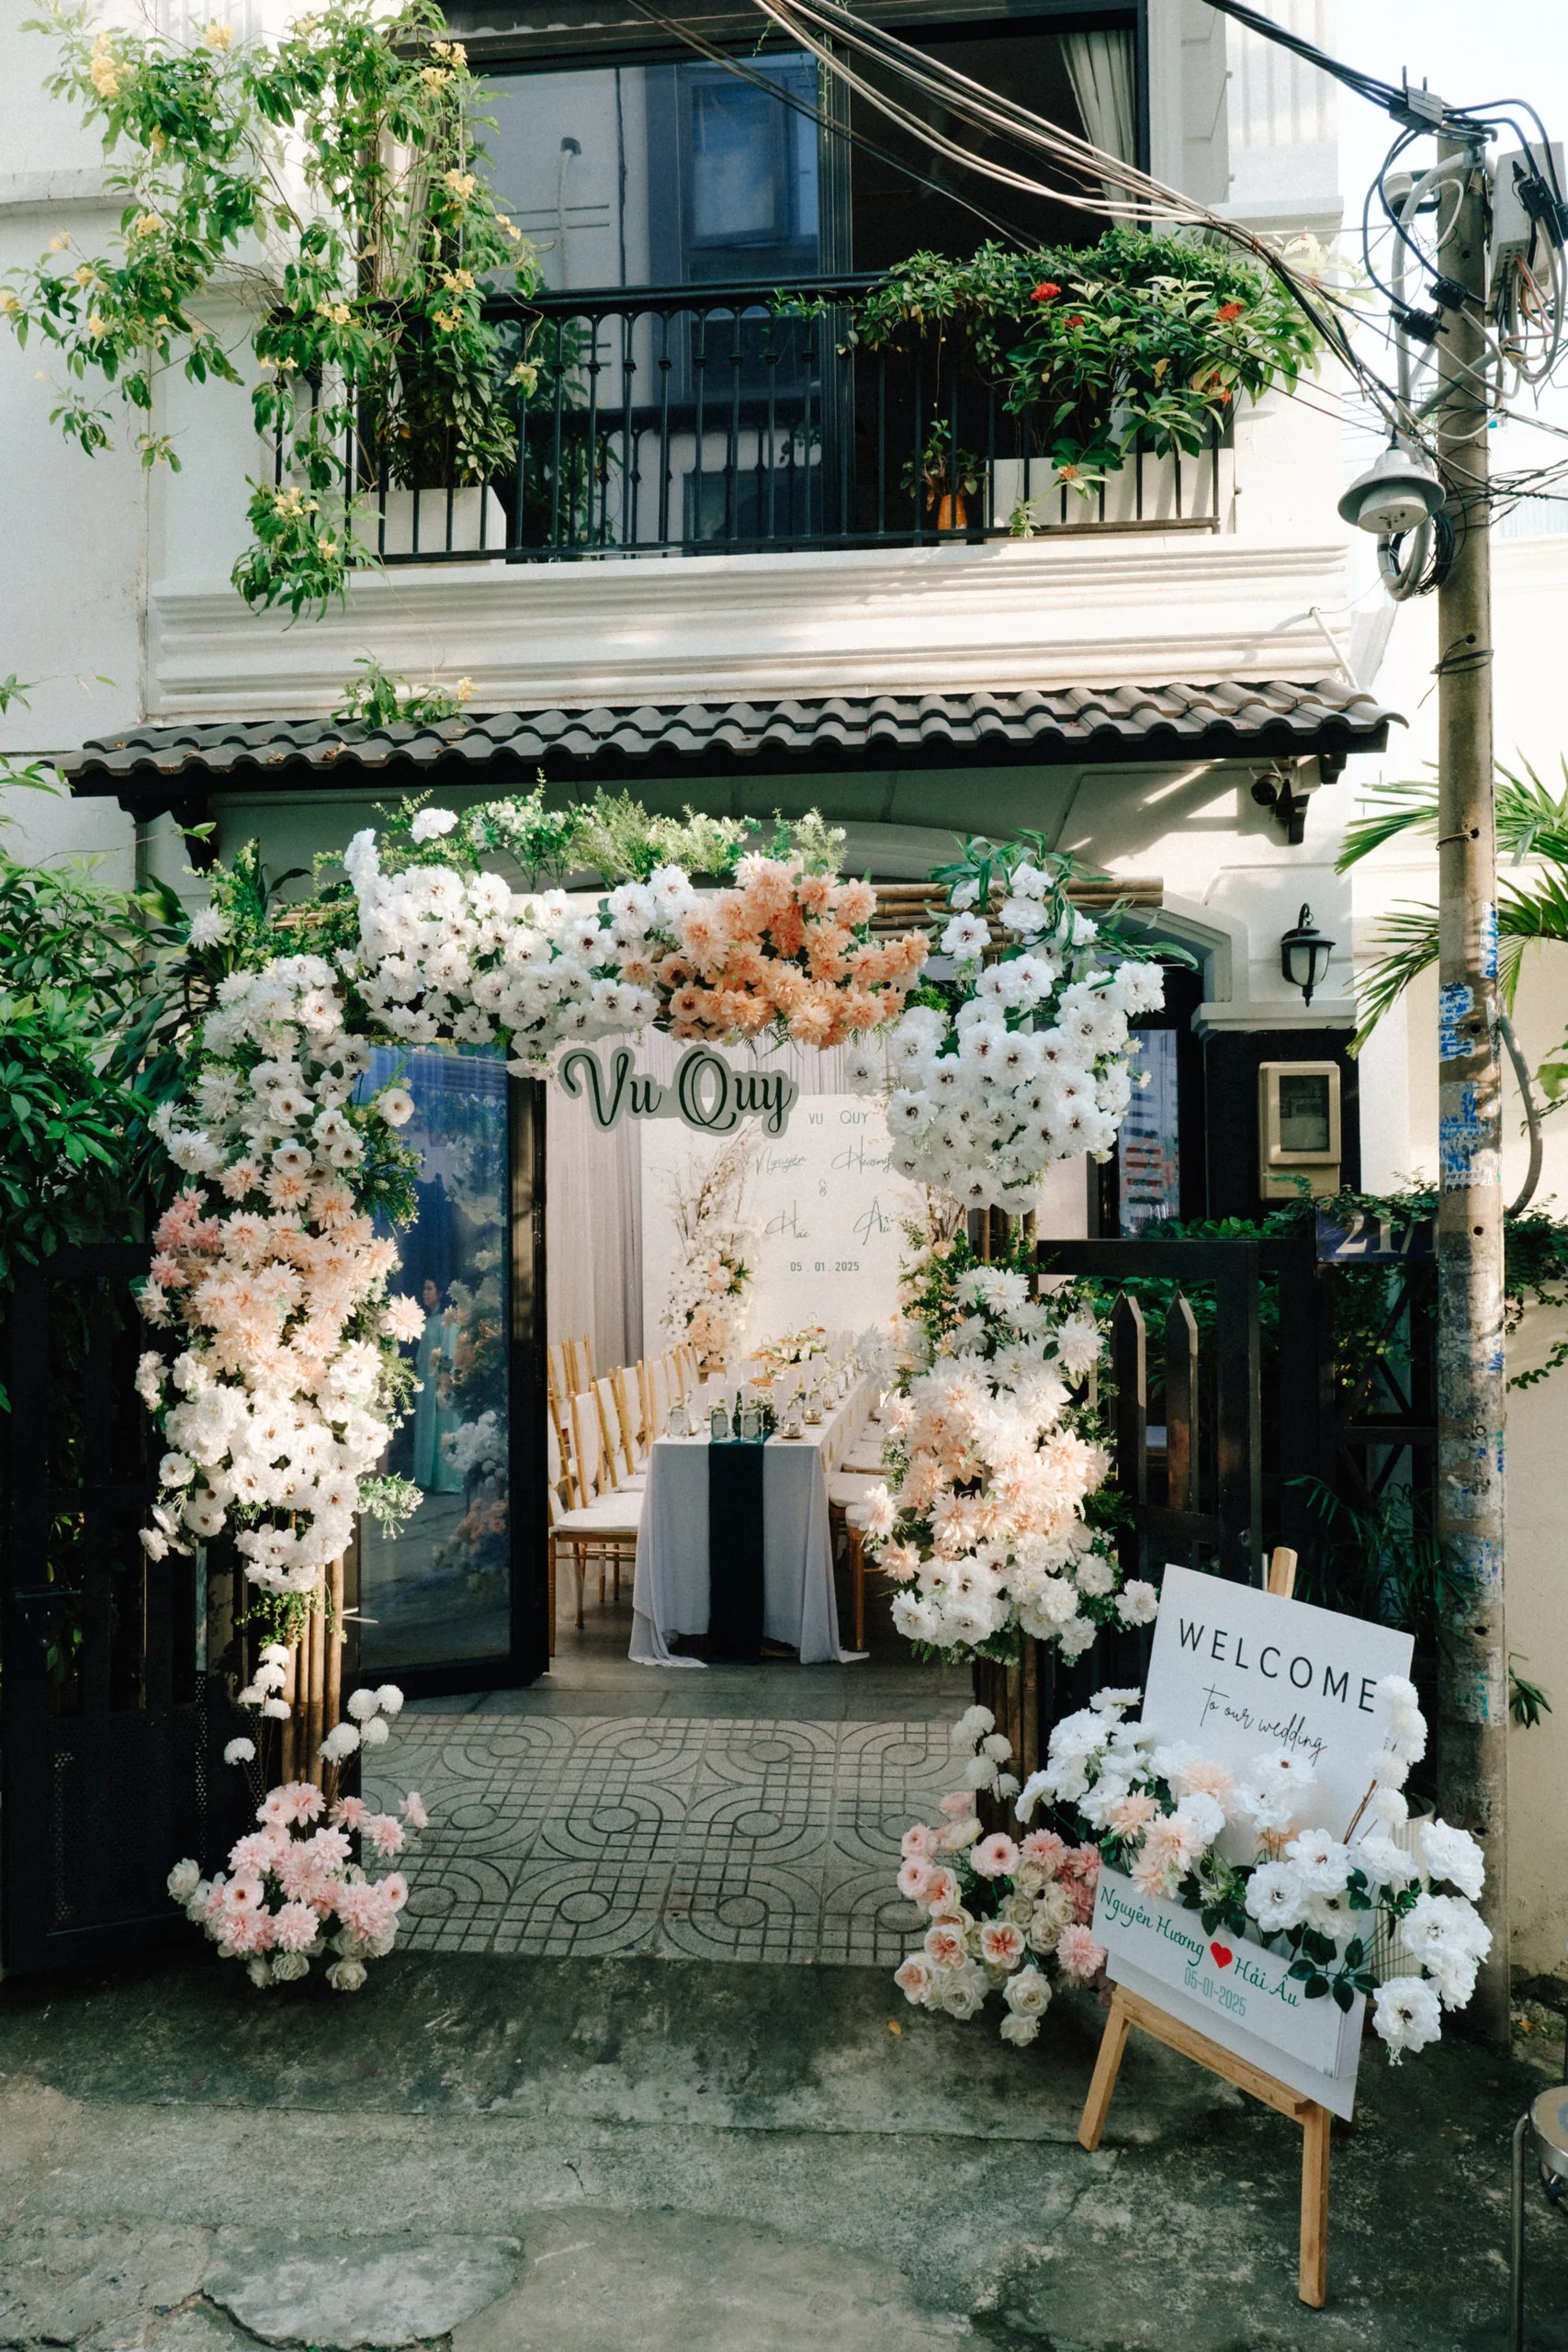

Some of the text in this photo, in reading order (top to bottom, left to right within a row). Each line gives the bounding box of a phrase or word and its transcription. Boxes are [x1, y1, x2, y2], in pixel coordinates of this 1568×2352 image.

[564, 1050, 793, 1134] Vu Quy
[808, 1110, 869, 1125] VU QUY
[1179, 1617, 1378, 1713] WELCOME
[1224, 1707, 1255, 1730] our
[1258, 1713, 1328, 1768] wedding
[1100, 1885, 1301, 2007] Nguyên Hương Hải Âu
[1184, 1966, 1247, 2018] 05-01-2025
